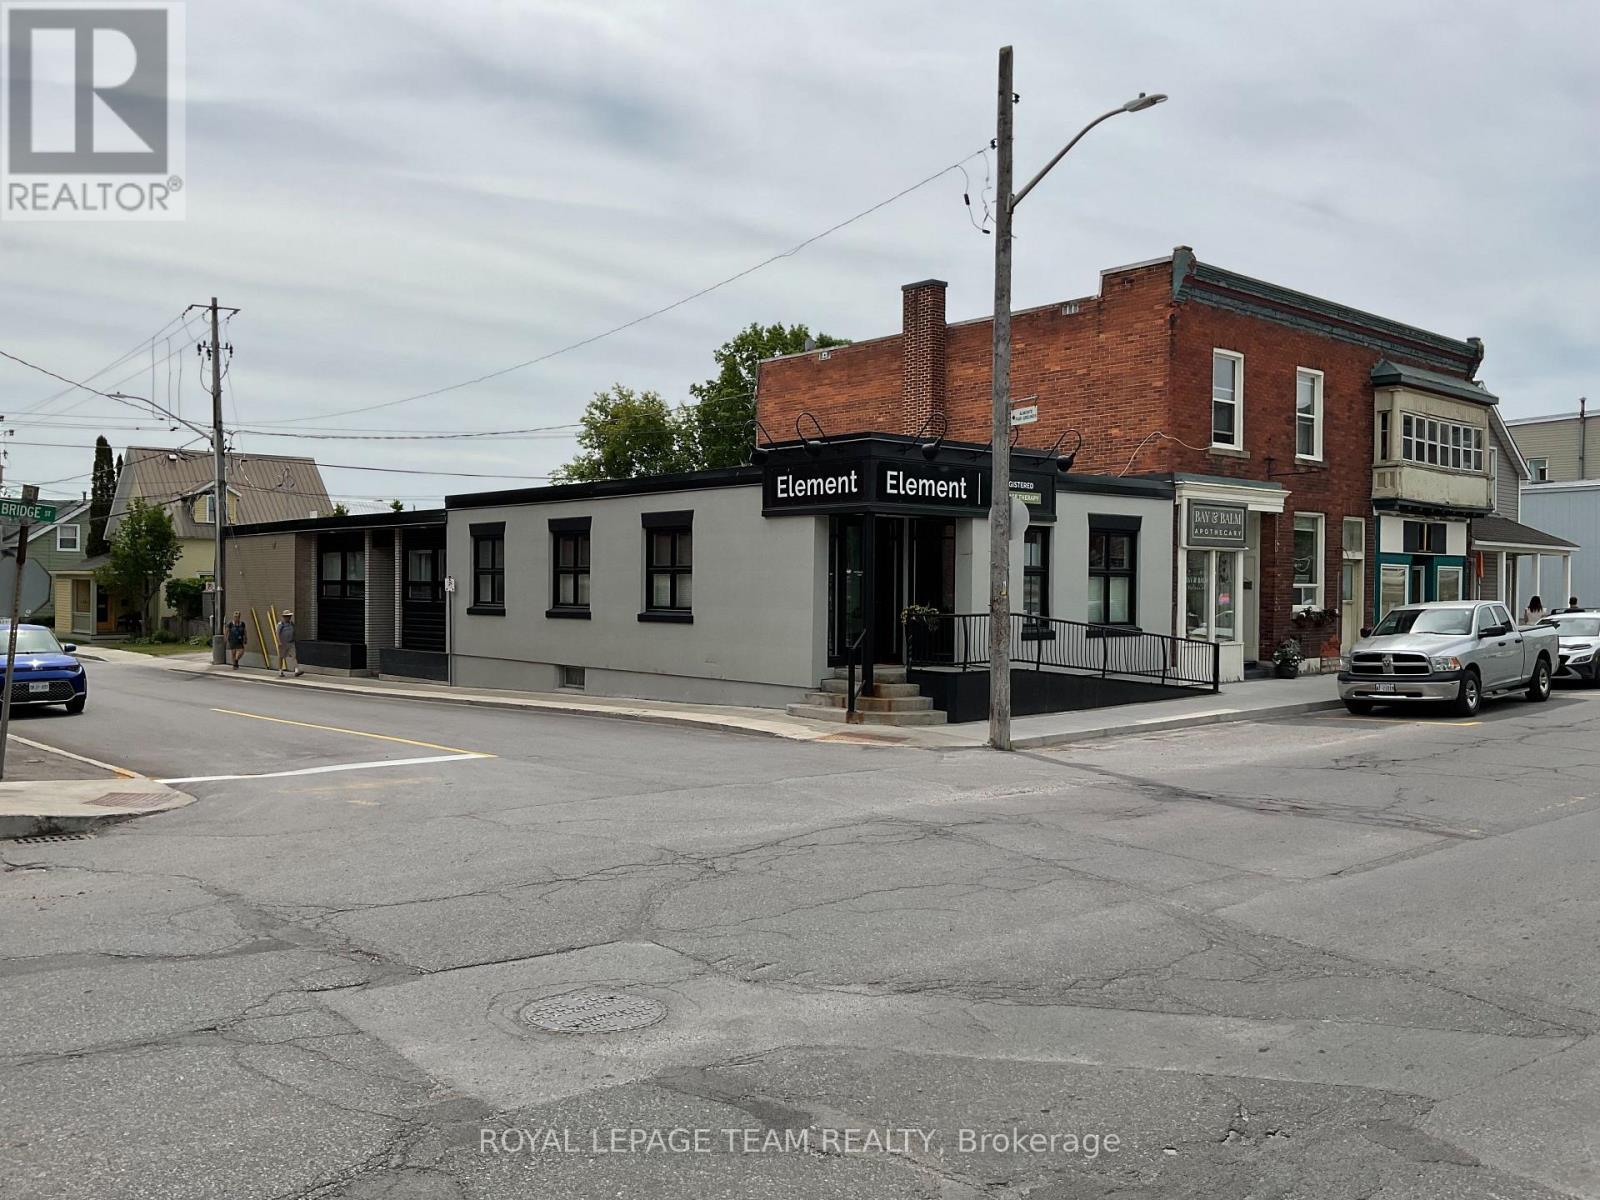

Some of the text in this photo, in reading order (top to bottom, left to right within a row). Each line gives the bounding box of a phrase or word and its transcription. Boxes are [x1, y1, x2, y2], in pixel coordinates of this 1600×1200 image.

[777, 470, 858, 498] Element
[886, 470, 967, 499] Element
[1008, 480, 1034, 489] GISTERED
[1, 502, 41, 519] BRIDGE
[1194, 510, 1241, 525] BAY & BALM
[1194, 528, 1241, 536] APOTHECARY
